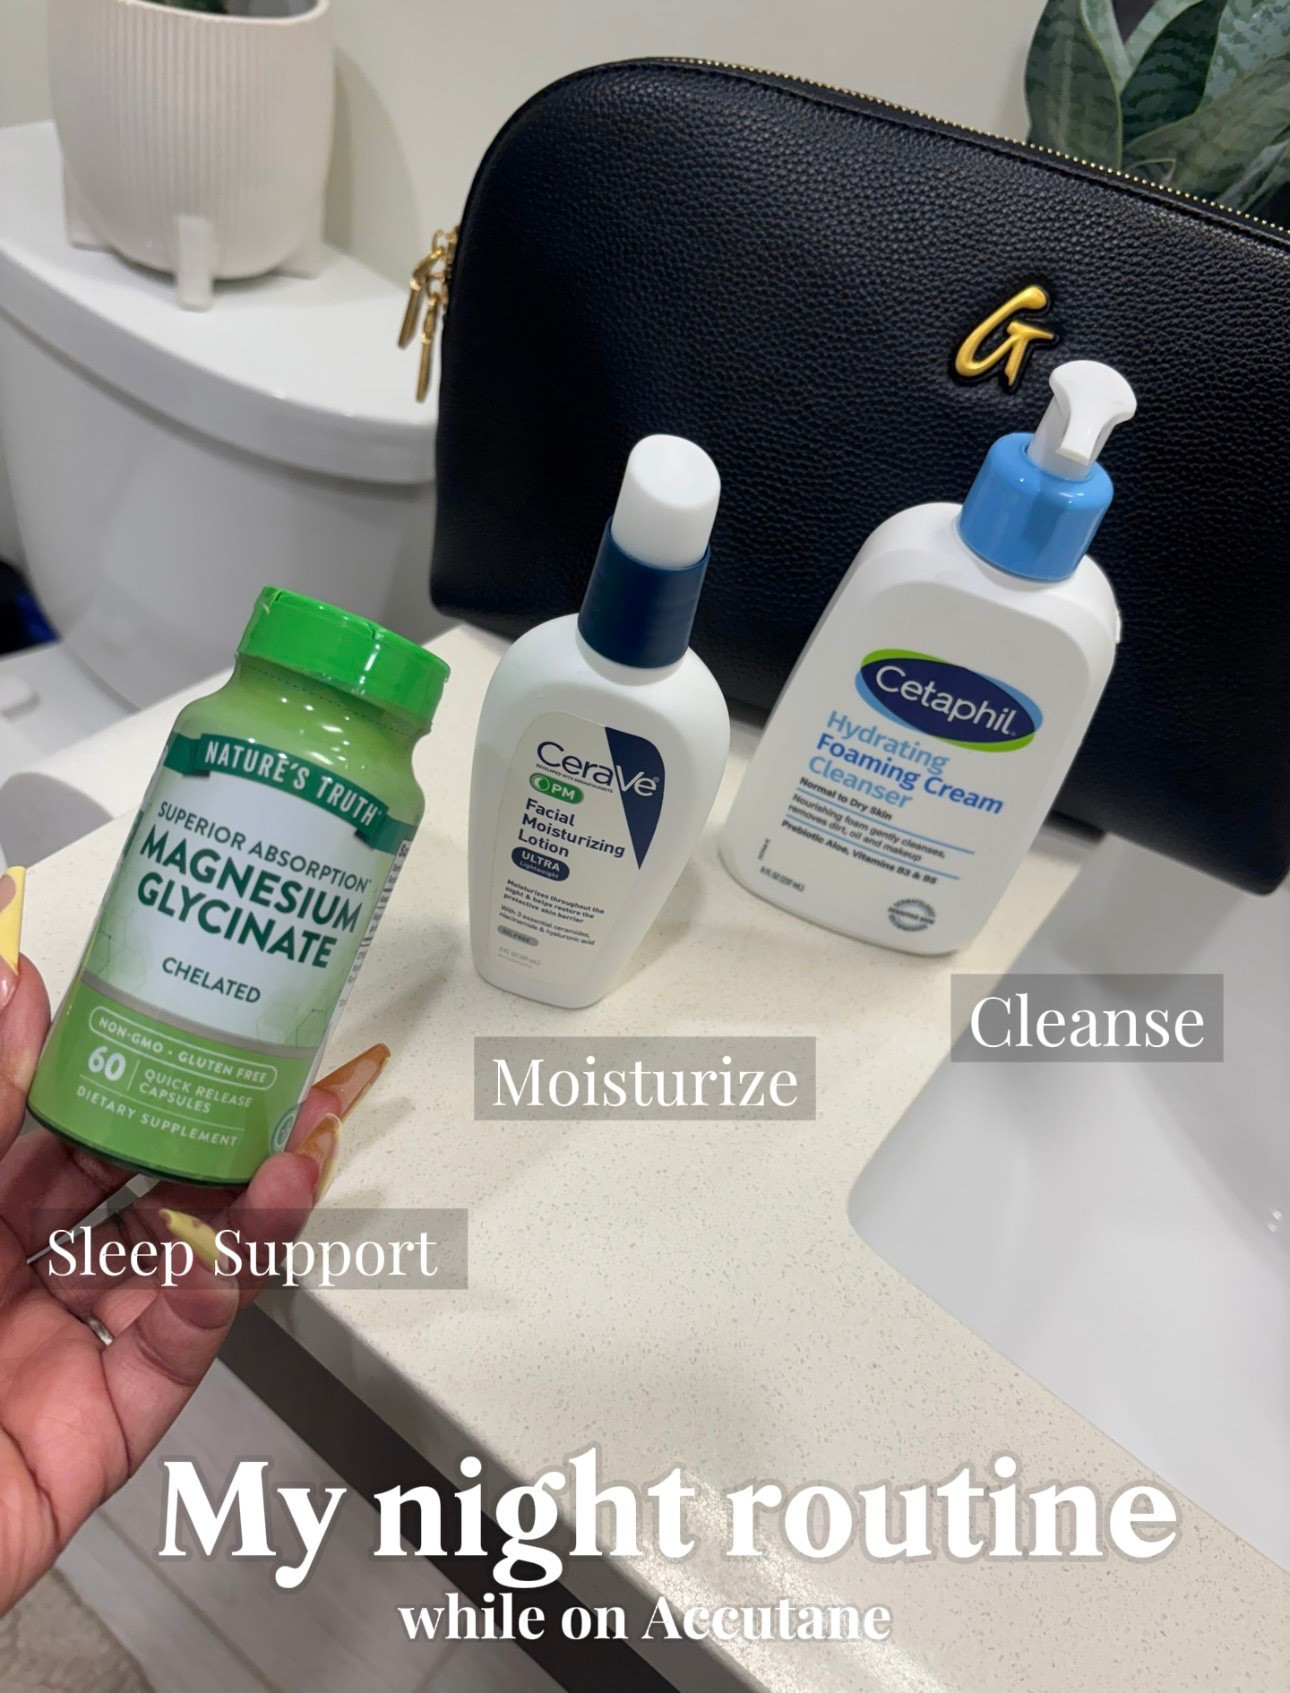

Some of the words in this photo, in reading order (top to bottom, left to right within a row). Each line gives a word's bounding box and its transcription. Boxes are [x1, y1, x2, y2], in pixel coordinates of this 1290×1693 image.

[955, 285, 1053, 386] G
[876, 664, 1017, 736] Cetaphil
[204, 740, 310, 791] NATURE'S
[826, 710, 950, 775] Hydrating
[551, 785, 576, 800] PM
[809, 755, 913, 809] Cleanser
[816, 733, 921, 791] Foaming
[923, 775, 1004, 815] Cream
[526, 798, 575, 827] Facial
[800, 777, 836, 798] Normal
[838, 793, 848, 803] to
[849, 798, 868, 812] Dry
[869, 806, 892, 820] Skin
[158, 801, 246, 851] SUPERIOR
[518, 829, 570, 857] Lotion
[522, 813, 626, 858] Moisturizing
[781, 819, 824, 844] Prebiotic
[825, 839, 849, 855] Aloe,
[852, 849, 895, 871] Vitamins
[788, 805, 827, 826] removes
[829, 822, 847, 835] dirt,
[849, 830, 862, 839] oil
[863, 836, 882, 848] and
[883, 843, 922, 861] makeup
[792, 793, 843, 822] Nourishing
[844, 816, 869, 831] foam
[869, 828, 900, 843] gently
[901, 839, 945, 859] cleanses,
[140, 823, 363, 934] MAGNESIUM
[521, 850, 560, 871] ULTRA
[137, 871, 338, 969] GLYCINATE
[501, 904, 516, 915] With
[503, 893, 539, 911] protective
[541, 907, 557, 916] skin
[558, 912, 584, 923] barrier
[505, 886, 524, 897] night
[533, 897, 553, 908] helps
[554, 904, 581, 916] restore
[507, 879, 549, 899] Moisturizes
[550, 895, 591, 911] throughout
[592, 907, 605, 915] the
[162, 957, 261, 1004] CHELATED
[87, 1045, 126, 1081] 60
[98, 1016, 164, 1054] NON-GMO
[177, 1051, 233, 1077] GLUTEN
[236, 1067, 268, 1084] FREE
[139, 1083, 212, 1114] CAPSULES
[144, 1068, 192, 1094] QUICK
[196, 1086, 253, 1109] RELEASE
[76, 1085, 137, 1119] DIETARY
[140, 1113, 238, 1147] SUPPLEMENT
